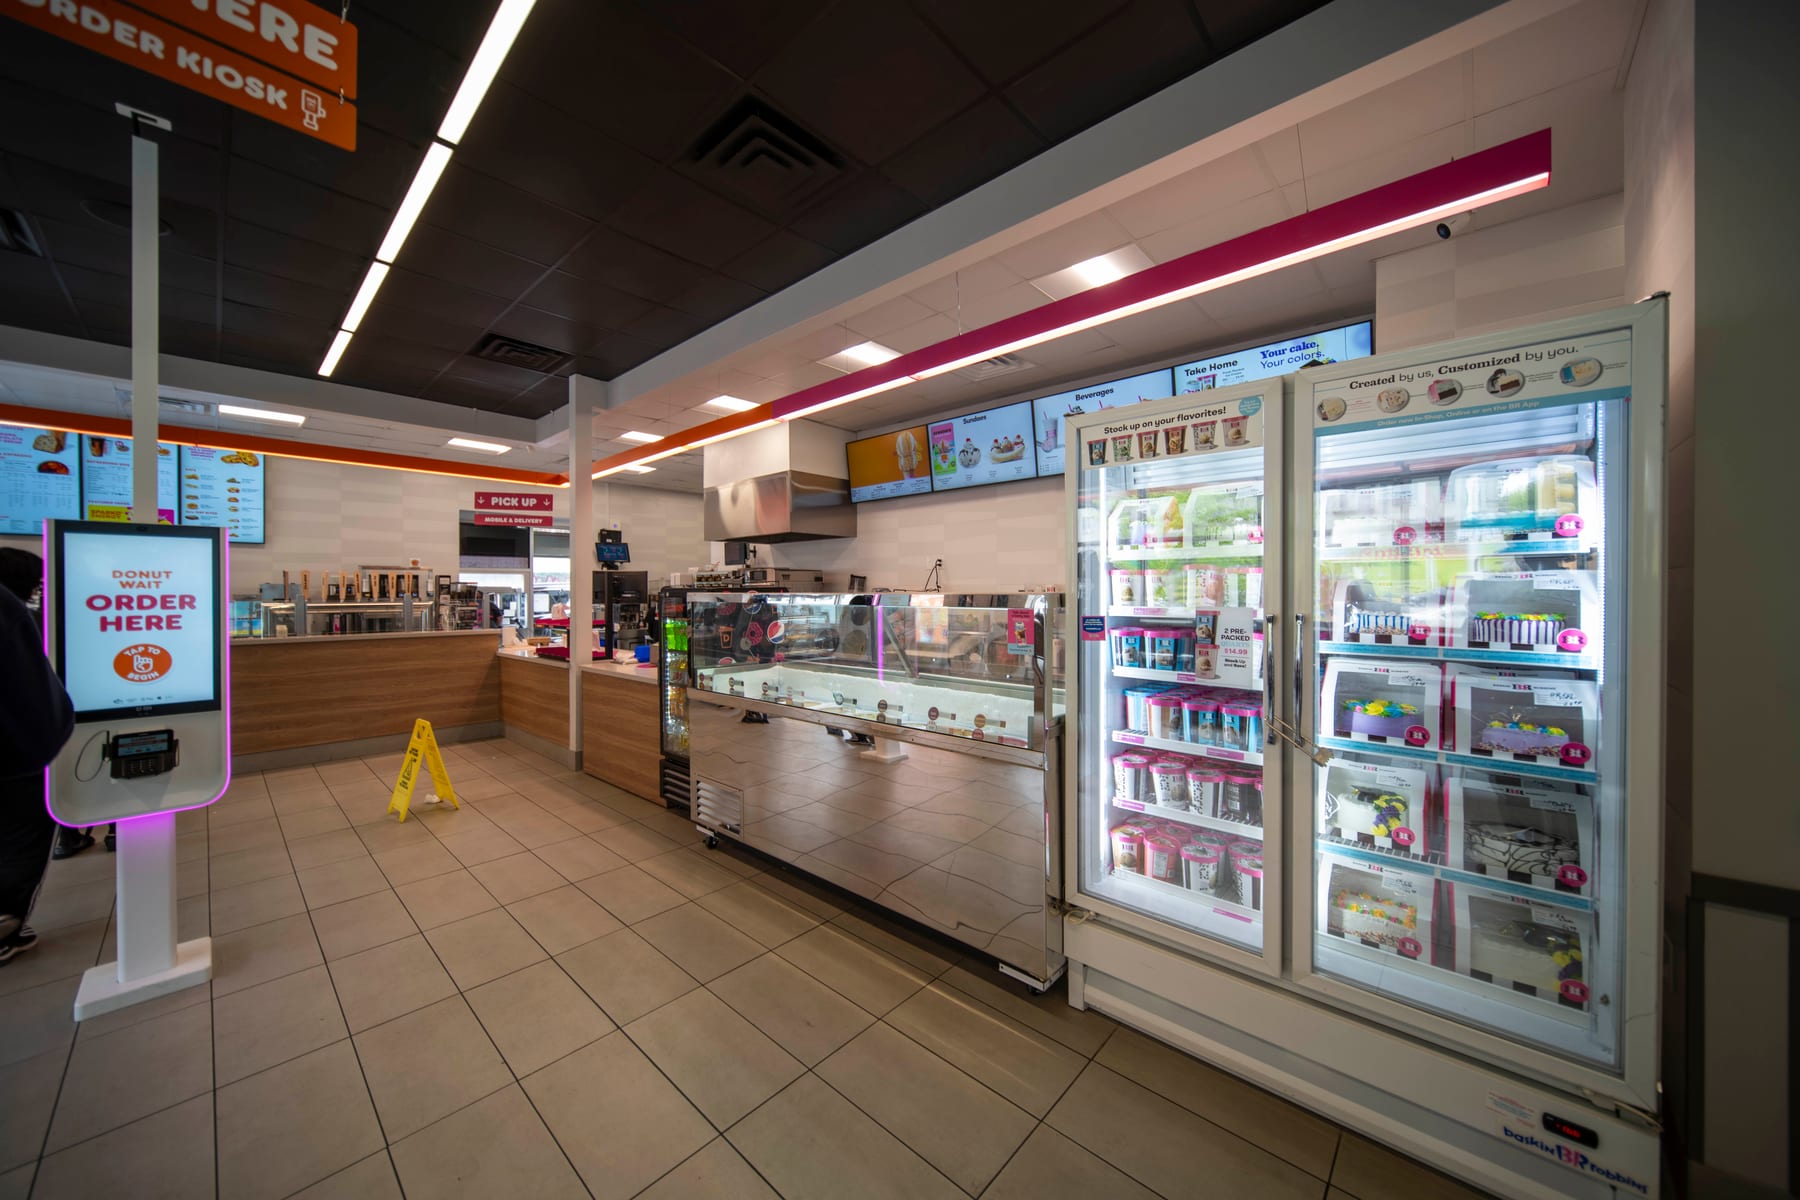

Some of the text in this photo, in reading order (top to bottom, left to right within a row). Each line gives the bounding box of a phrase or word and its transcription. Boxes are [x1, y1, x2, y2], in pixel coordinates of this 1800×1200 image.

[177, 46, 288, 111] KIOSK
[1260, 340, 1320, 360] Your cake.
[1184, 359, 1239, 378] Take Home
[1260, 349, 1326, 370] Your colors.
[1349, 374, 1396, 390] Created
[1399, 371, 1414, 383] by
[1416, 368, 1435, 379] us,
[1437, 353, 1521, 376] Customized
[1525, 350, 1543, 362] by
[1547, 345, 1580, 360] you.
[1075, 386, 1114, 401] Beverages
[962, 414, 987, 425] Sundaes
[1103, 406, 1227, 435] Stock up on your flavorites!
[1377, 418, 1397, 427] Order
[1398, 416, 1413, 425] now
[1446, 409, 1470, 418] Online
[1493, 404, 1508, 412] the
[1509, 402, 1521, 410] BR
[1522, 400, 1540, 410] App
[491, 496, 538, 507] PICK UP
[111, 570, 173, 579] DONUT
[119, 581, 163, 589] WAIT
[86, 594, 197, 612] ORDER
[99, 614, 183, 632] HERE
[124, 646, 161, 657] TAP TO
[127, 670, 160, 681] BEGIN
[1503, 1126, 1556, 1156] baskin
[1590, 1162, 1649, 1195] robbins
